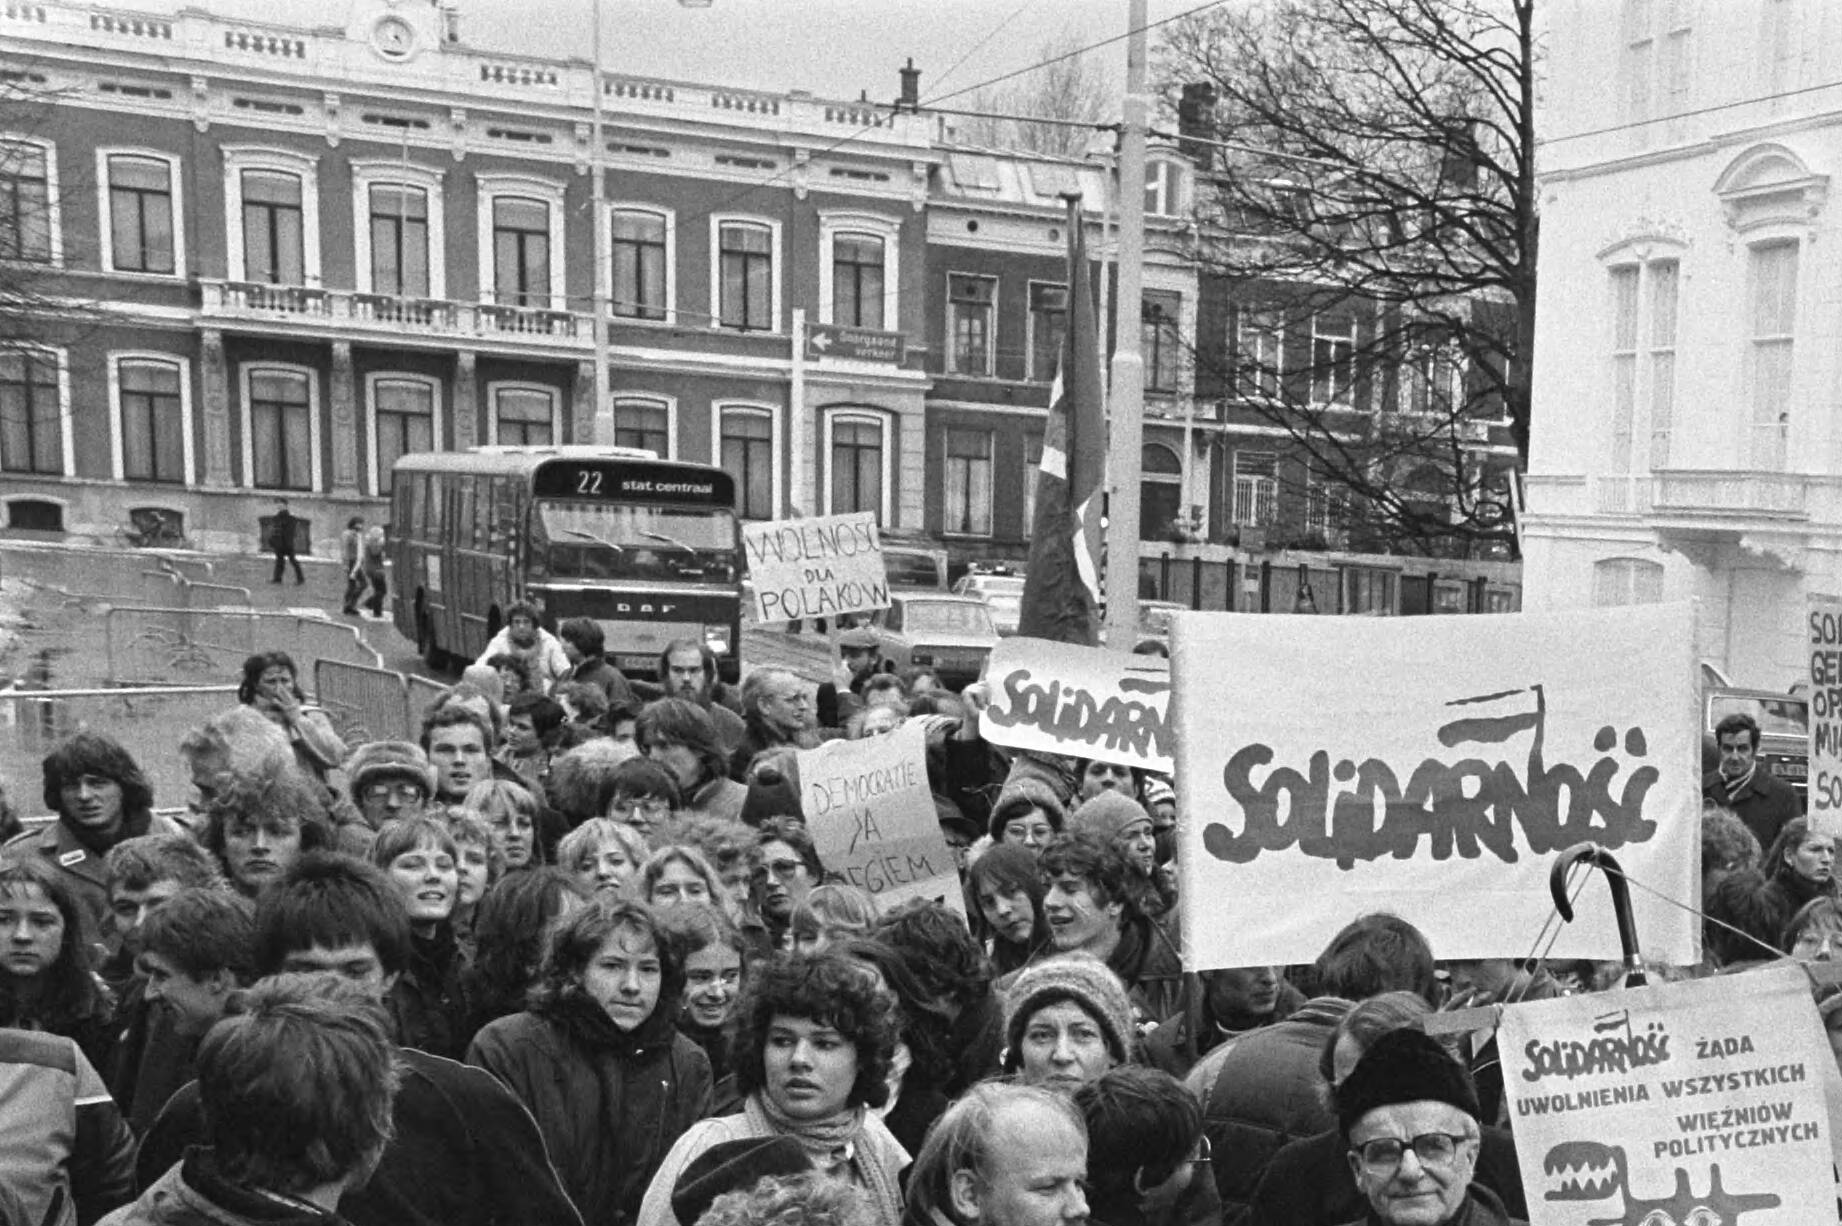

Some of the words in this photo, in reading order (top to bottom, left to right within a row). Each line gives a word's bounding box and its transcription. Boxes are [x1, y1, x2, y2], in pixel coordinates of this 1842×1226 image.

[577, 471, 602, 493] 22
[804, 568, 834, 584] DLA
[847, 855, 937, 894] EGIEM
[1695, 1035, 1754, 1060] ŻĄDA
[1516, 1083, 1650, 1117] UWOLNIENIA
[1661, 1062, 1806, 1099] WSZYSTKICH
[1653, 1121, 1819, 1159] POLITYCZNYCH
